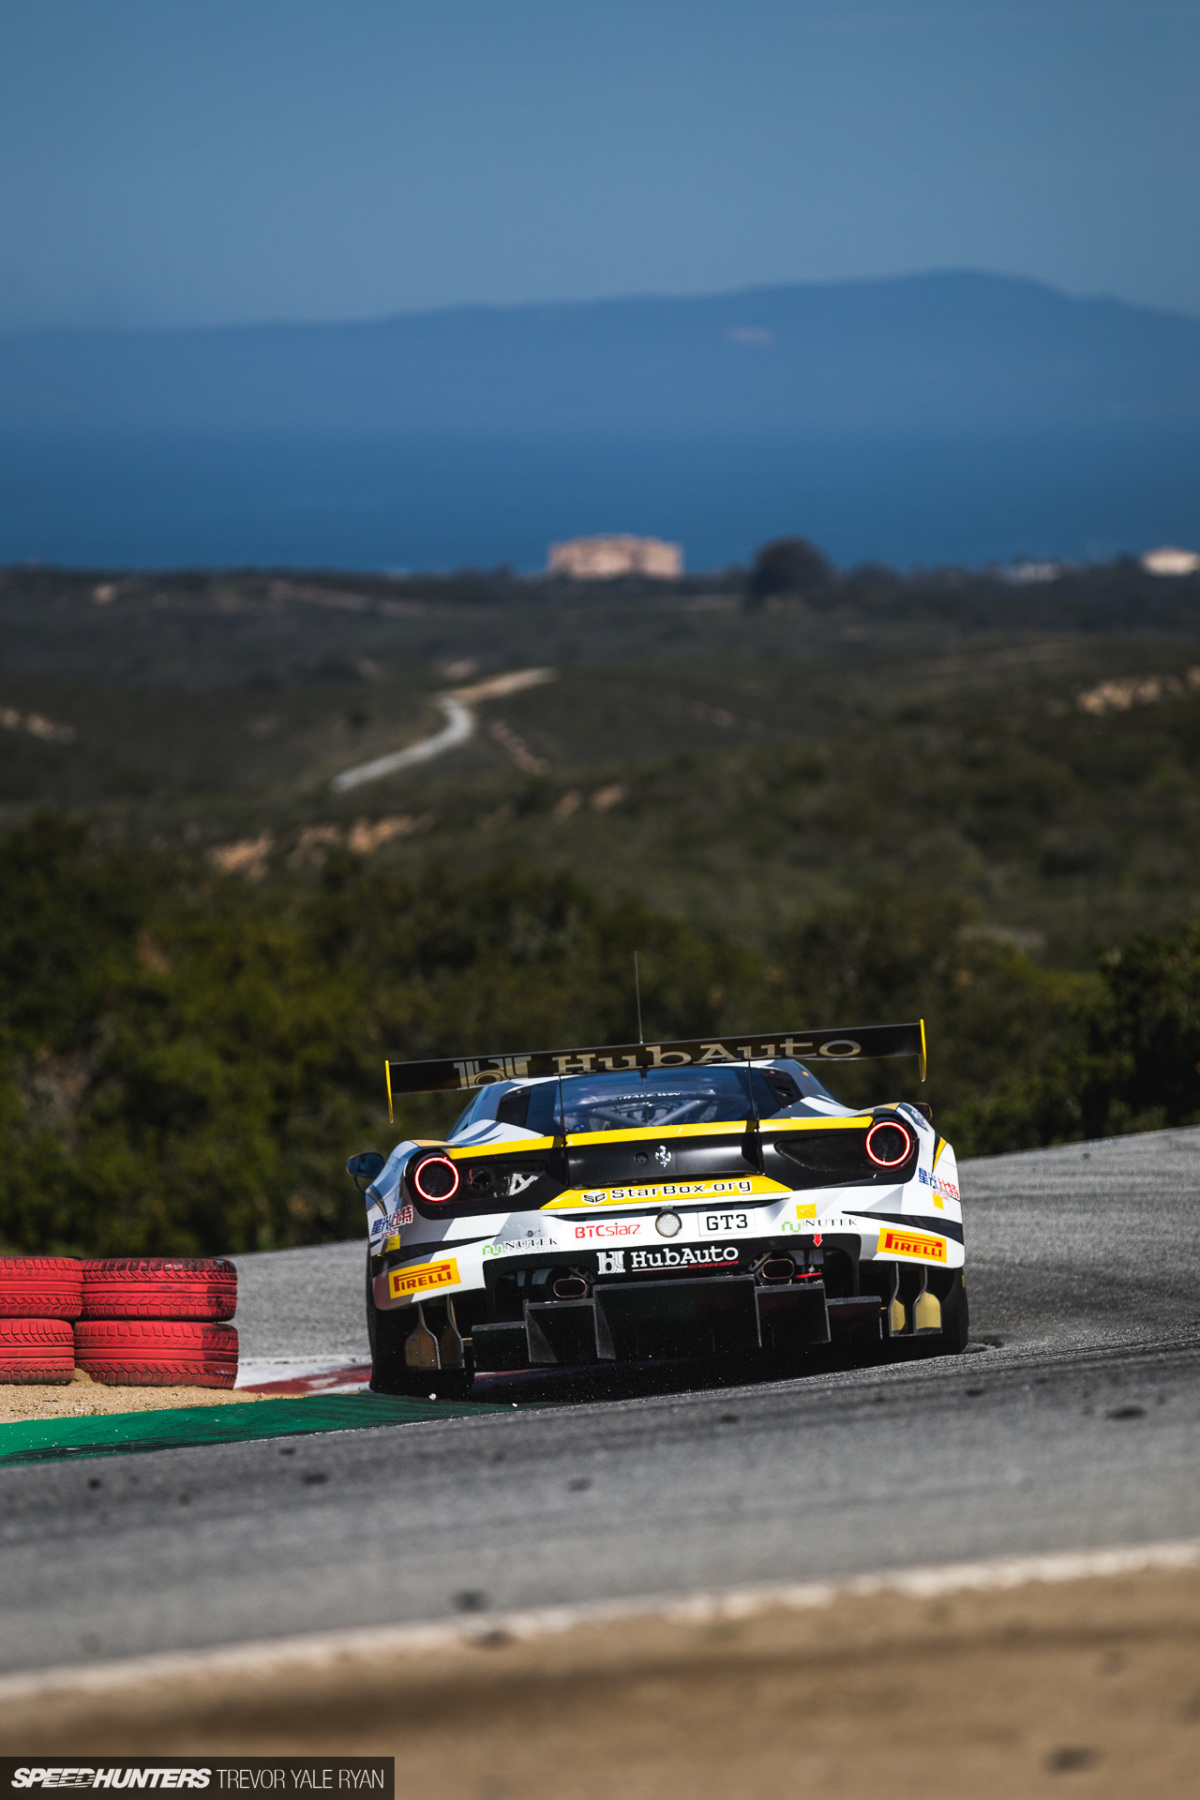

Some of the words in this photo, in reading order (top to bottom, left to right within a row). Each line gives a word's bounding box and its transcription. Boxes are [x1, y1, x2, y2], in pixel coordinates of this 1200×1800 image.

[611, 1180, 751, 1199] StarBox.org
[706, 1213, 748, 1231] GT3
[805, 1219, 857, 1227] NUTEK
[505, 1238, 558, 1249] NUTEK
[885, 1232, 943, 1258] PIRELLI
[630, 1246, 739, 1268] HubAuto
[393, 1264, 452, 1292] PIRELLI
